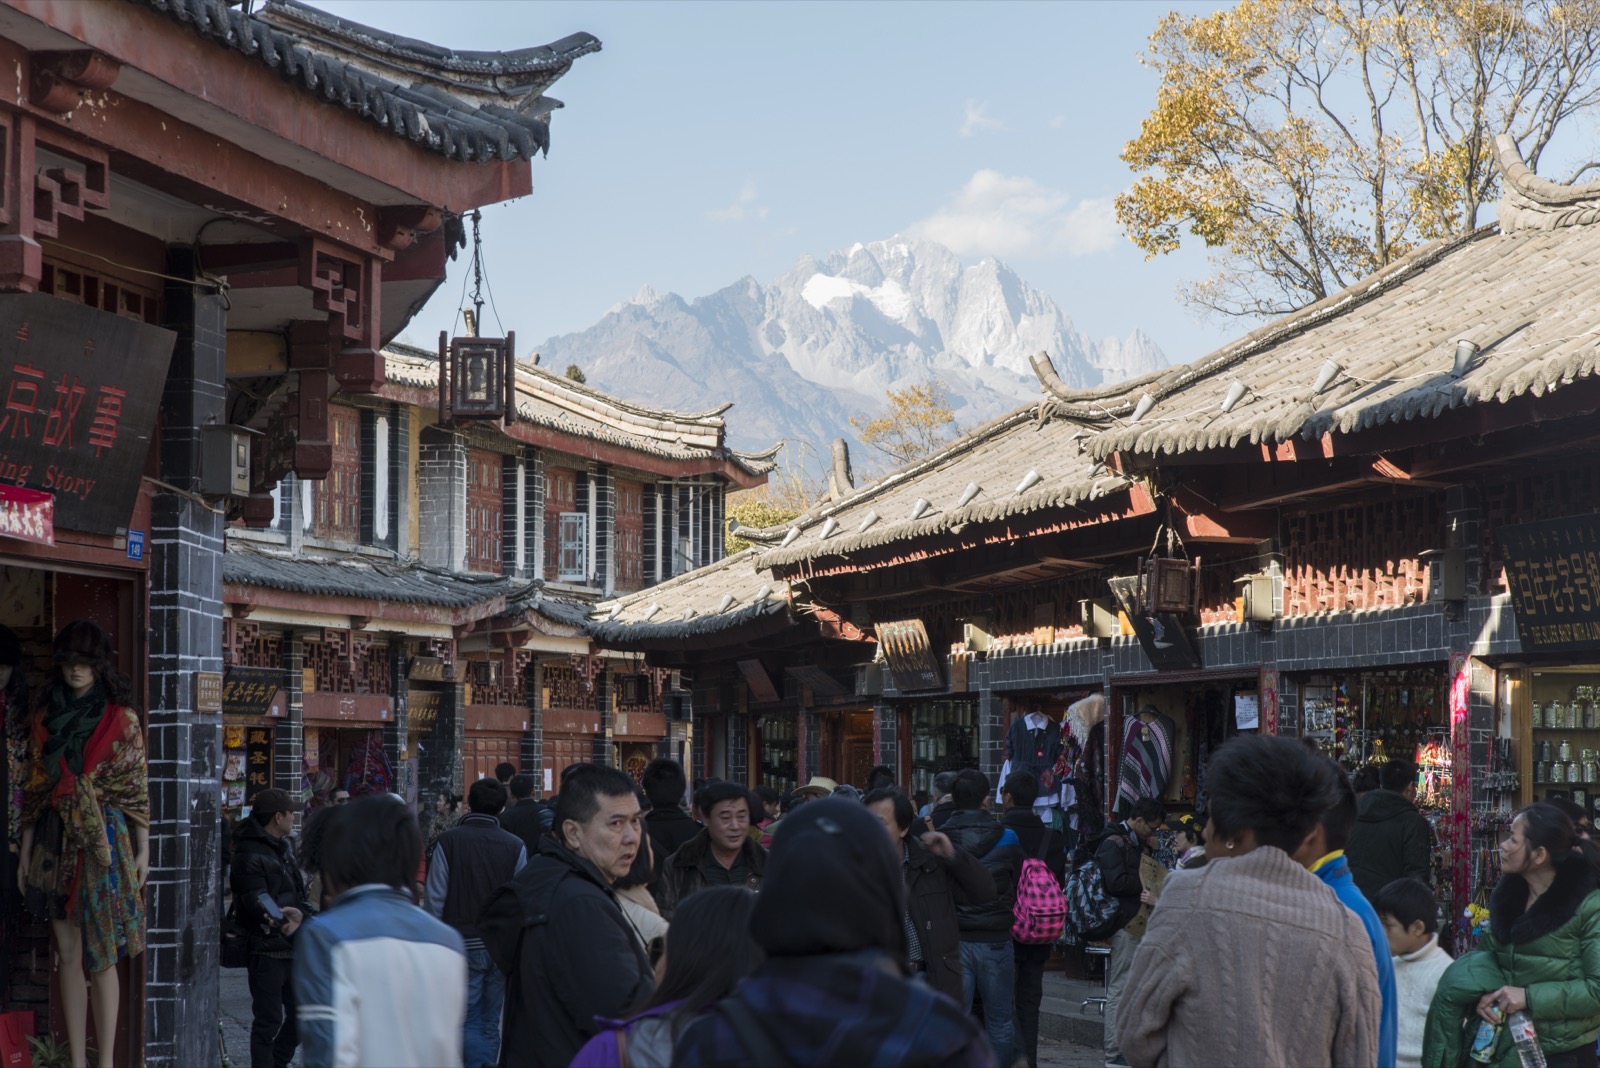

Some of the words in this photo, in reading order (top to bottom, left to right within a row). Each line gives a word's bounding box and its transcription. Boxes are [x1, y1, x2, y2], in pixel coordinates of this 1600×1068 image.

[0, 362, 127, 457] 京故事
[42, 464, 96, 500] Story
